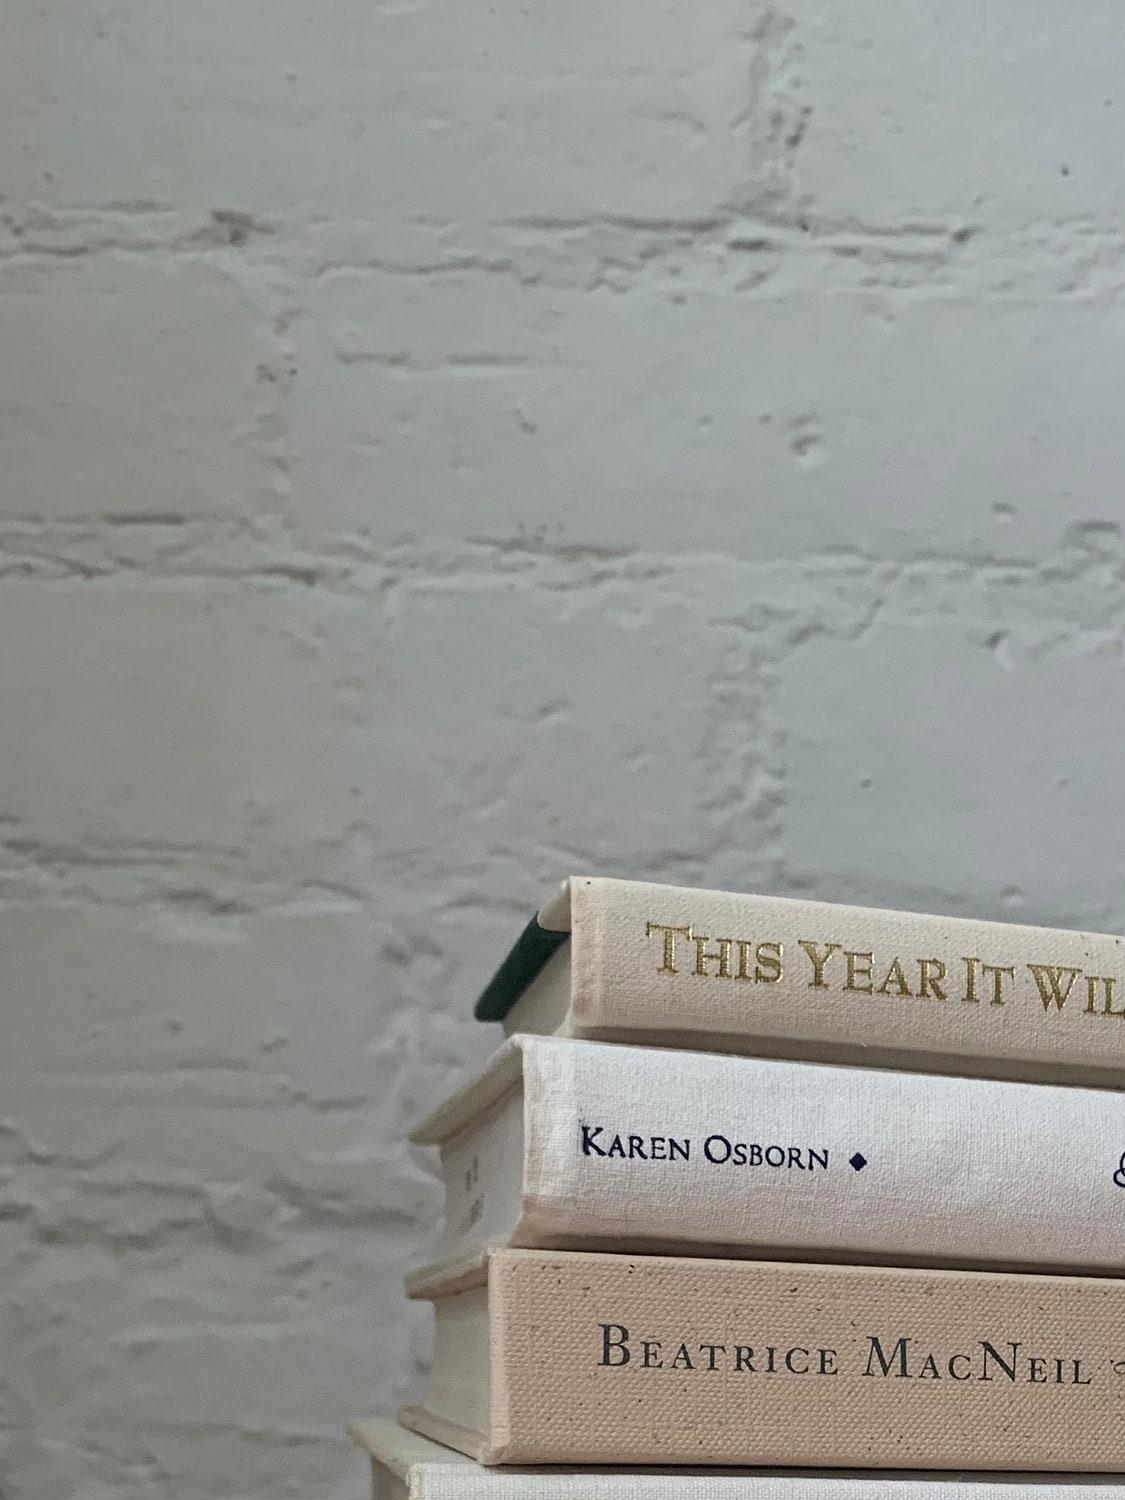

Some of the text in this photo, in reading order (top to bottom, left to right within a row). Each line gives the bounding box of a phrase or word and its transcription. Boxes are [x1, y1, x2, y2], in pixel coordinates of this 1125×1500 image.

[645, 922, 782, 986] THIS
[798, 940, 948, 1002] YEAR
[961, 957, 1014, 1007] IT
[581, 1125, 828, 1171] KAREN OSBORN
[597, 1324, 838, 1375] BEATRICE
